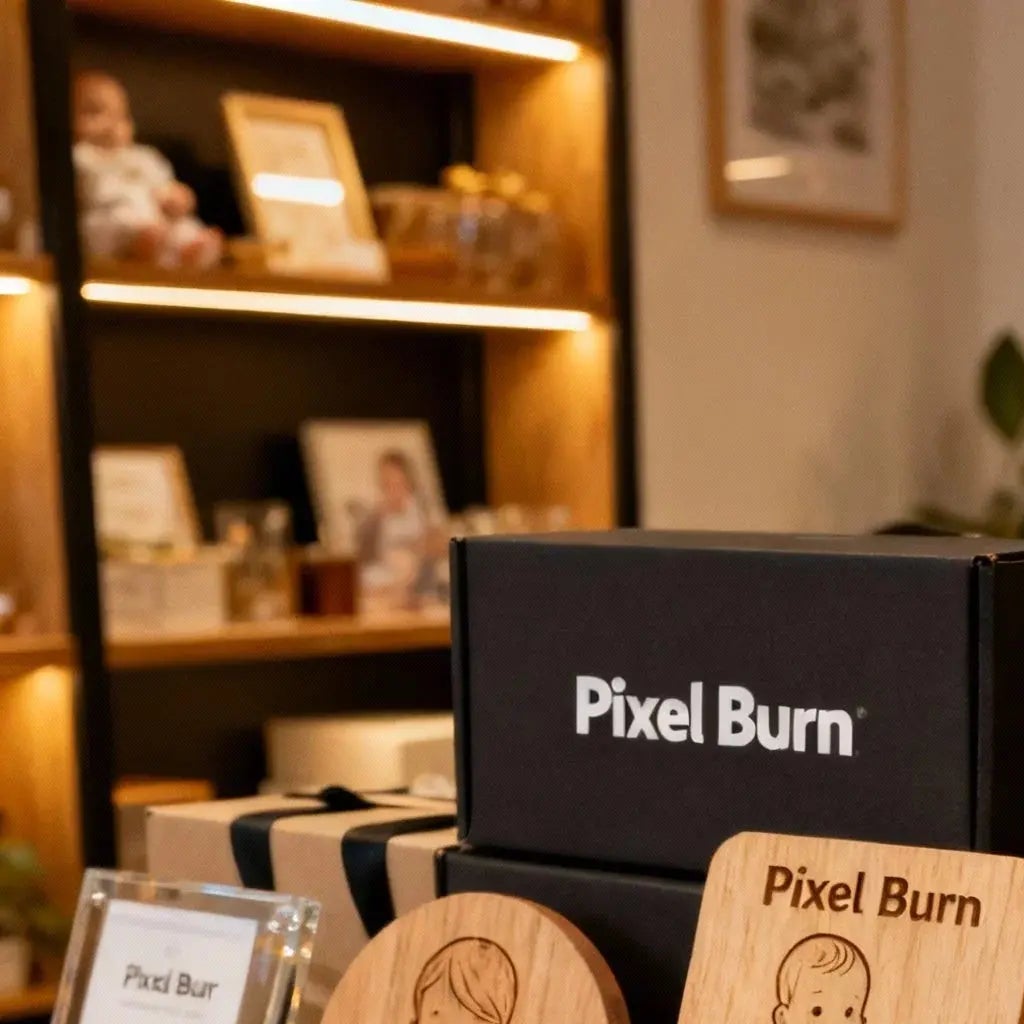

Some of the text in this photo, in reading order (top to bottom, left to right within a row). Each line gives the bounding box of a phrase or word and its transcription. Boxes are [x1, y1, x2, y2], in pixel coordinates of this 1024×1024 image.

[576, 675, 853, 756] Pixel Burn
[762, 865, 982, 927] Pixel Burn
